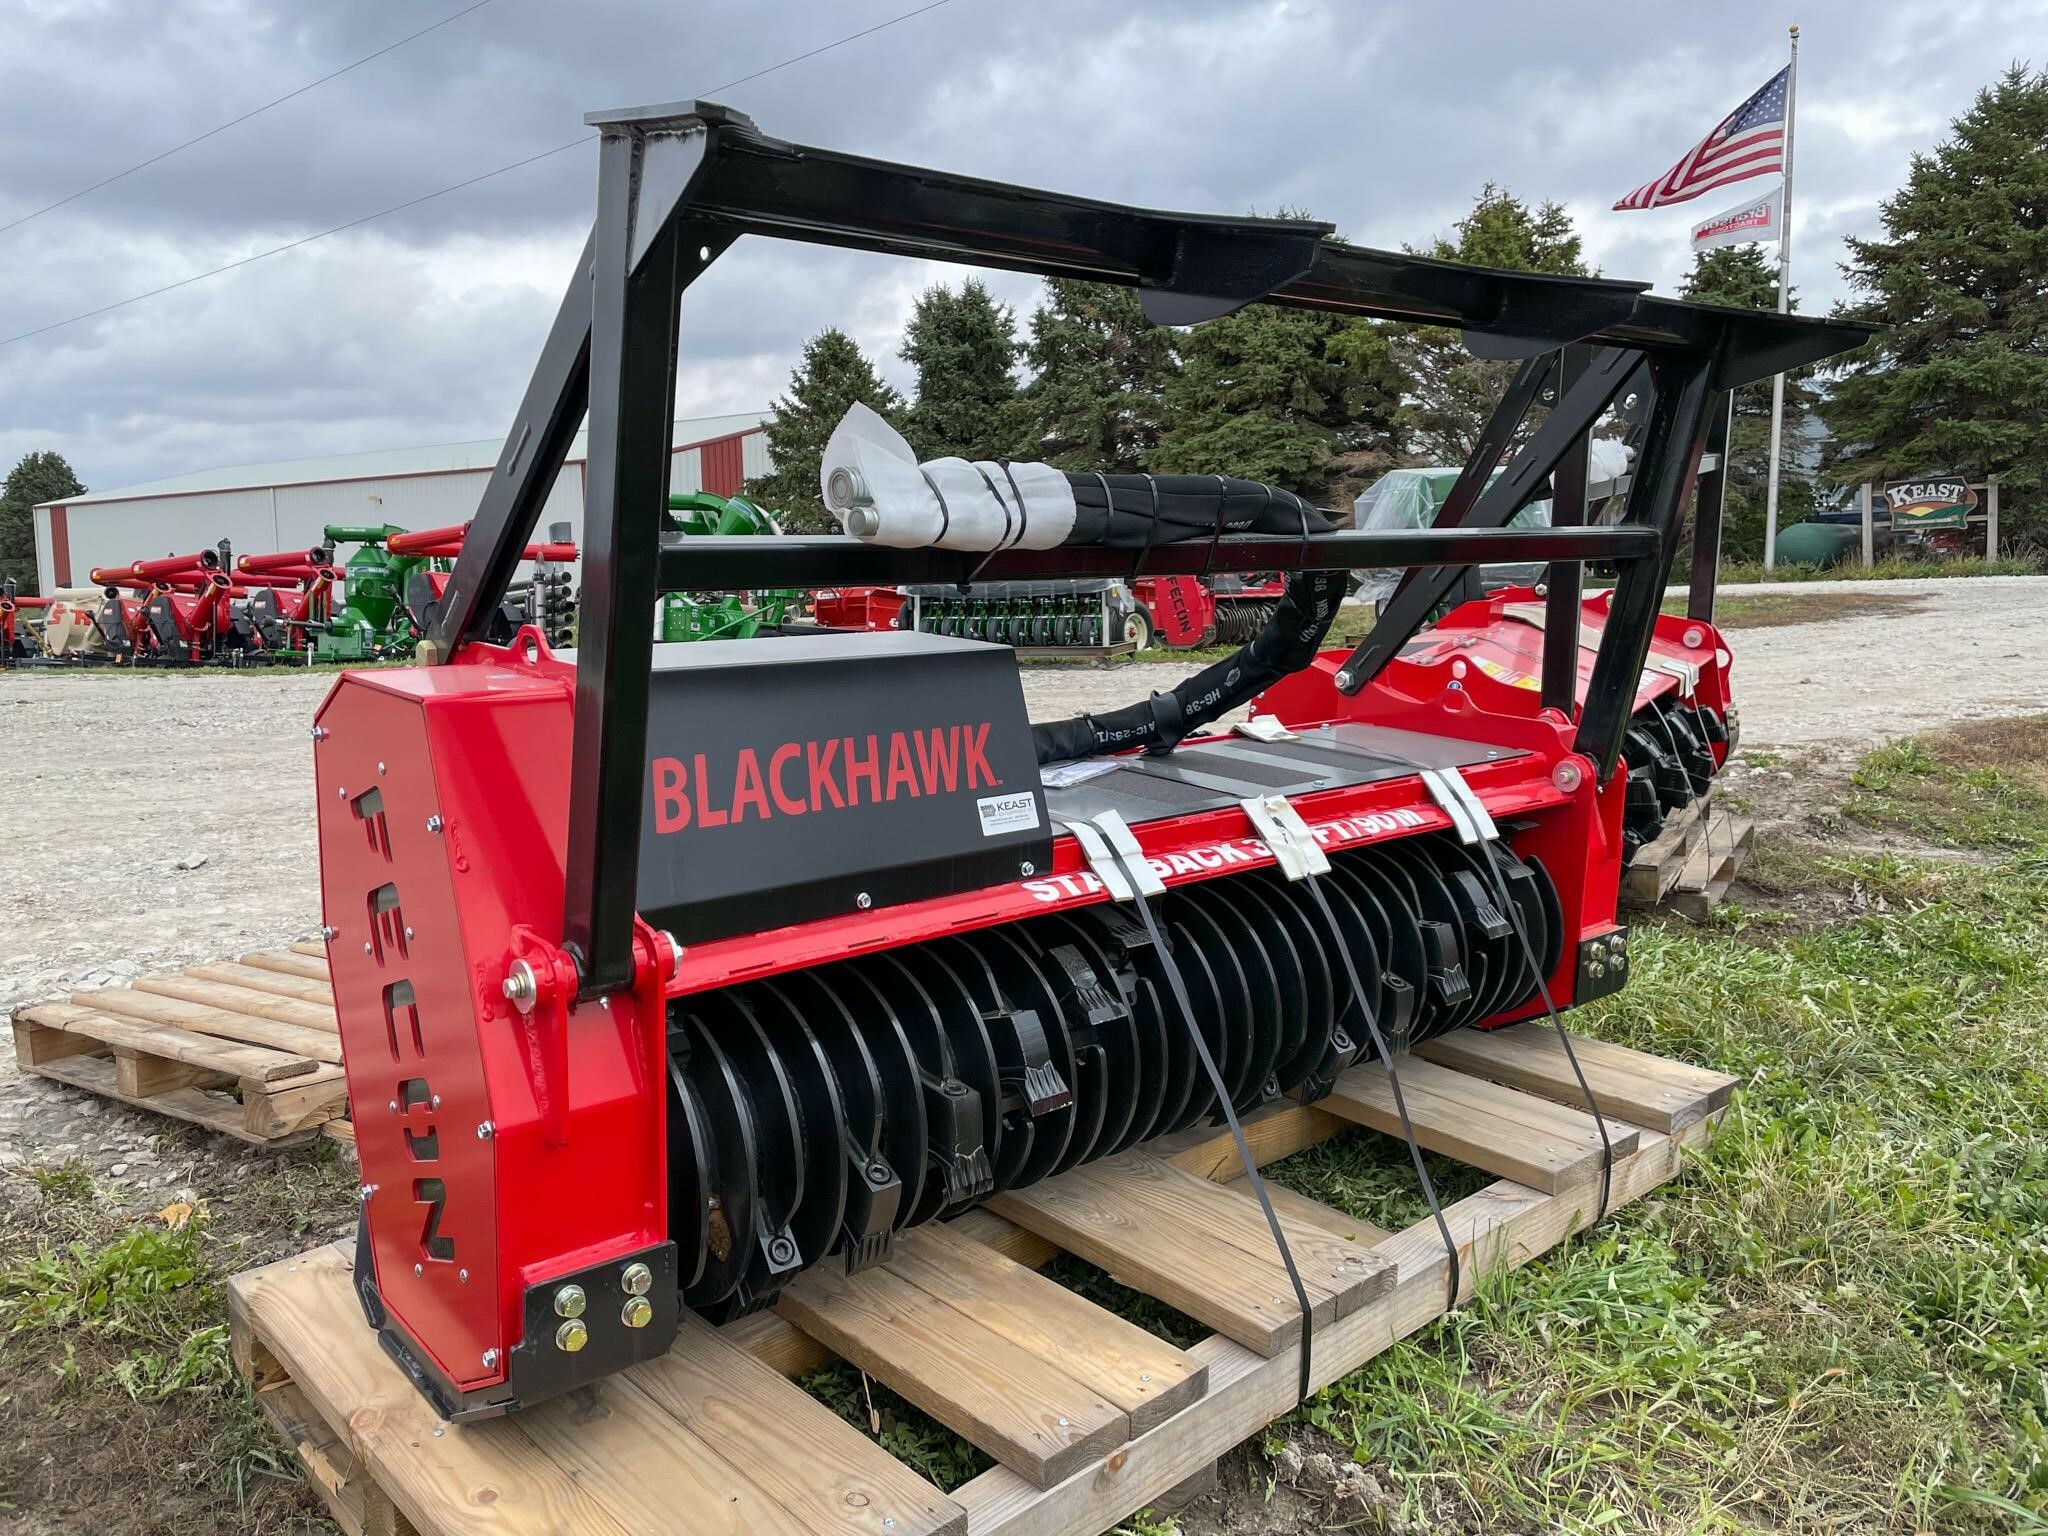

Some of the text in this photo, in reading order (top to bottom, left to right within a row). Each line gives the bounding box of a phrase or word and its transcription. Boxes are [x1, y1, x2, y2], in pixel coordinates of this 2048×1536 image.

[1887, 483, 1965, 508] KEAST
[1186, 688, 1221, 715] HG-38
[652, 723, 1000, 834] BLACKHAWK
[996, 798, 1032, 811] KEAST
[1021, 871, 1104, 902] STA
[1145, 842, 1253, 879] BACK
[350, 785, 456, 1264] FECON
